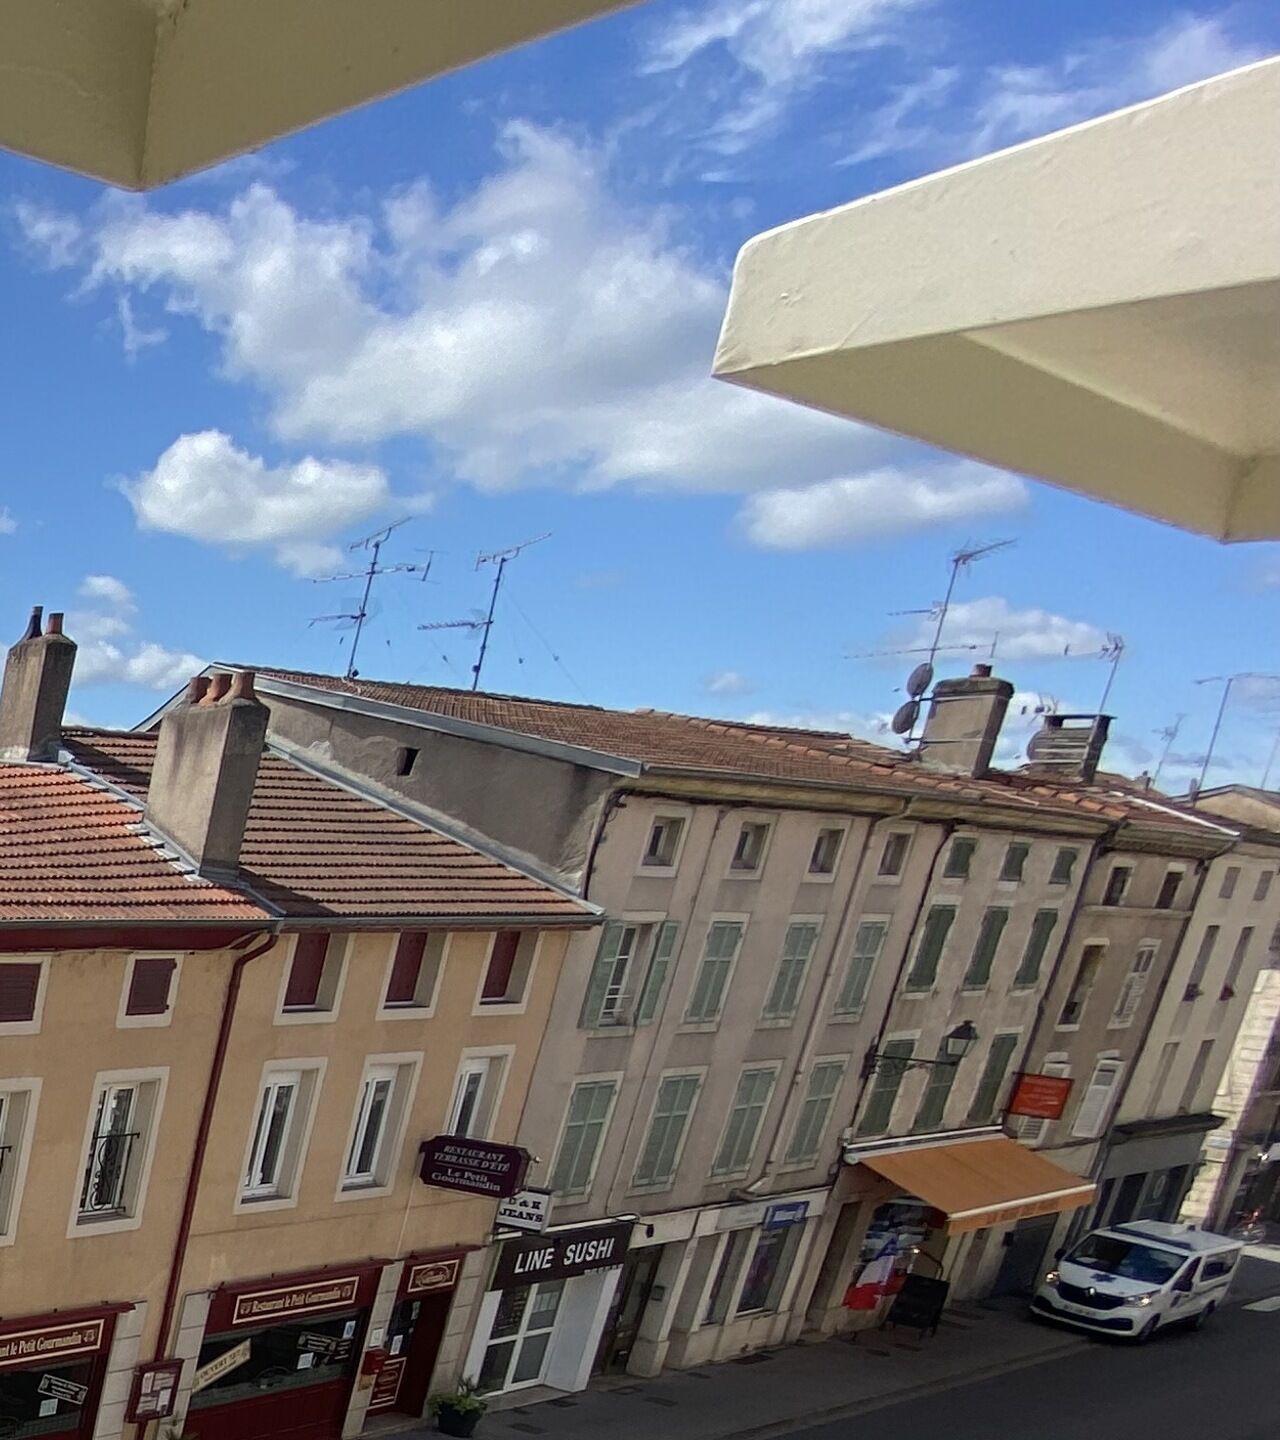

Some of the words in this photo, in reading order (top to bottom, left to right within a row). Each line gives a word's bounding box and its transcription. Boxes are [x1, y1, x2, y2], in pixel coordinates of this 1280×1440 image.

[434, 1152, 481, 1167] TERRASSE
[443, 1145, 506, 1162] RESTAURANT
[432, 1171, 501, 1191] Gourmandin
[447, 1168, 462, 1178] Le
[464, 1171, 488, 1182] Petit
[499, 1208, 544, 1223] JEANS
[514, 1247, 555, 1274] LINE
[563, 1238, 615, 1266] SUSHI
[251, 1298, 285, 1313] Restaurant
[290, 1293, 306, 1307] Petit
[10, 1342, 18, 1356] le
[18, 1339, 36, 1354] Petit
[37, 1331, 82, 1351] Gourmandin
